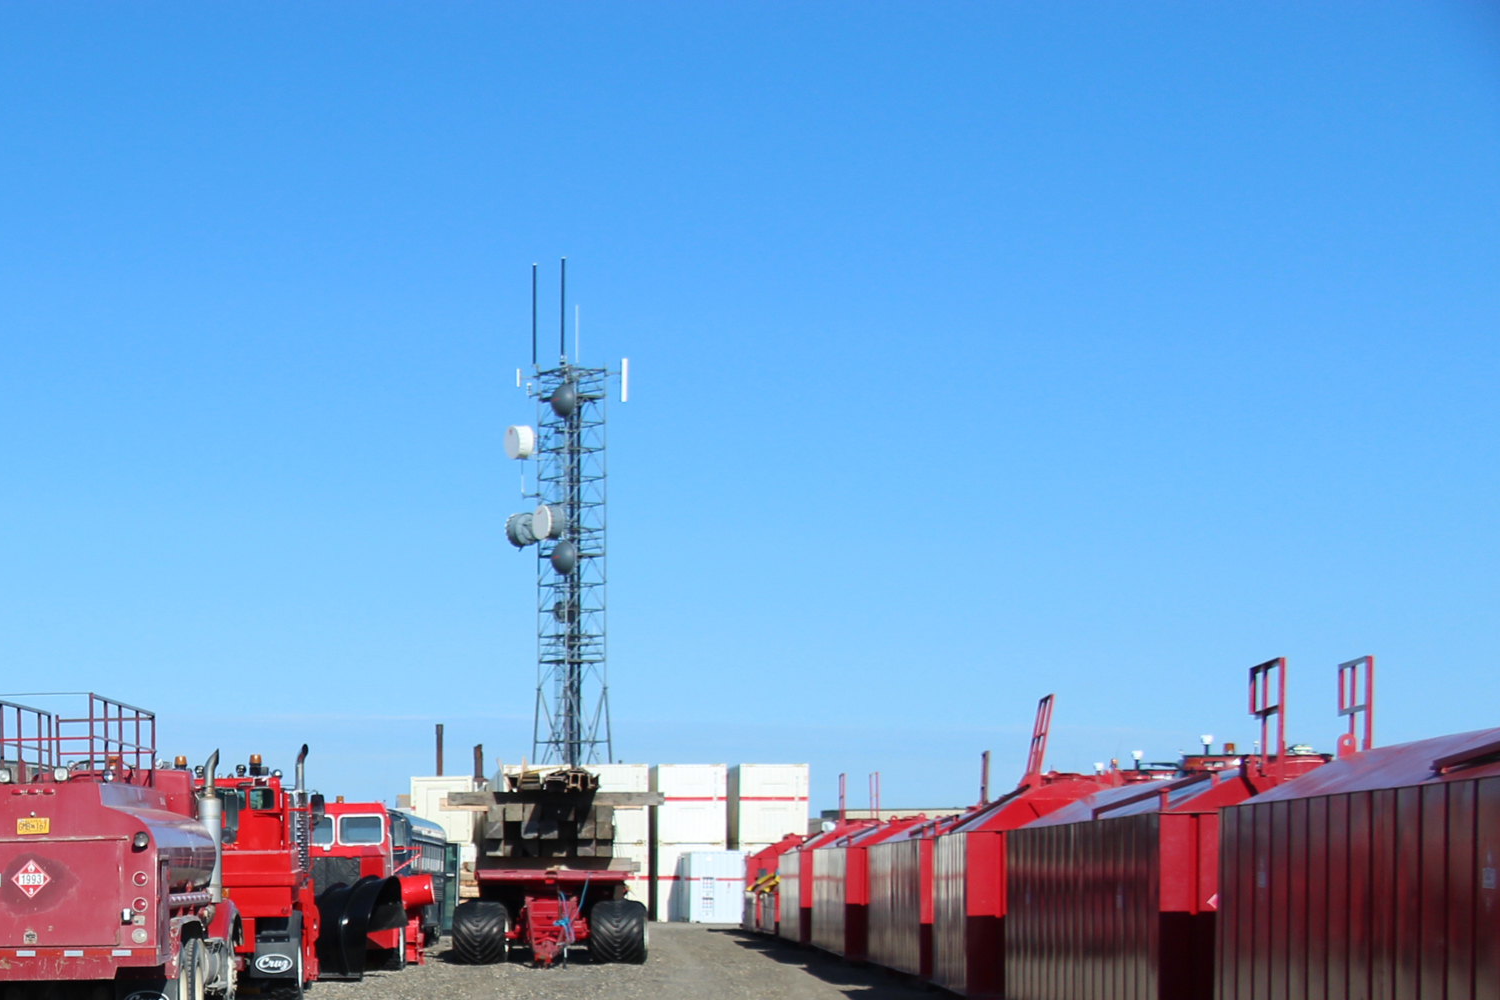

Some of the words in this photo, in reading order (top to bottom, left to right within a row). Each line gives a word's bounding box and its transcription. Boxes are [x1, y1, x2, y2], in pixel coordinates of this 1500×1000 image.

[21, 874, 42, 884] 1993
[28, 887, 34, 895] 3
[259, 957, 289, 971] Cruz
